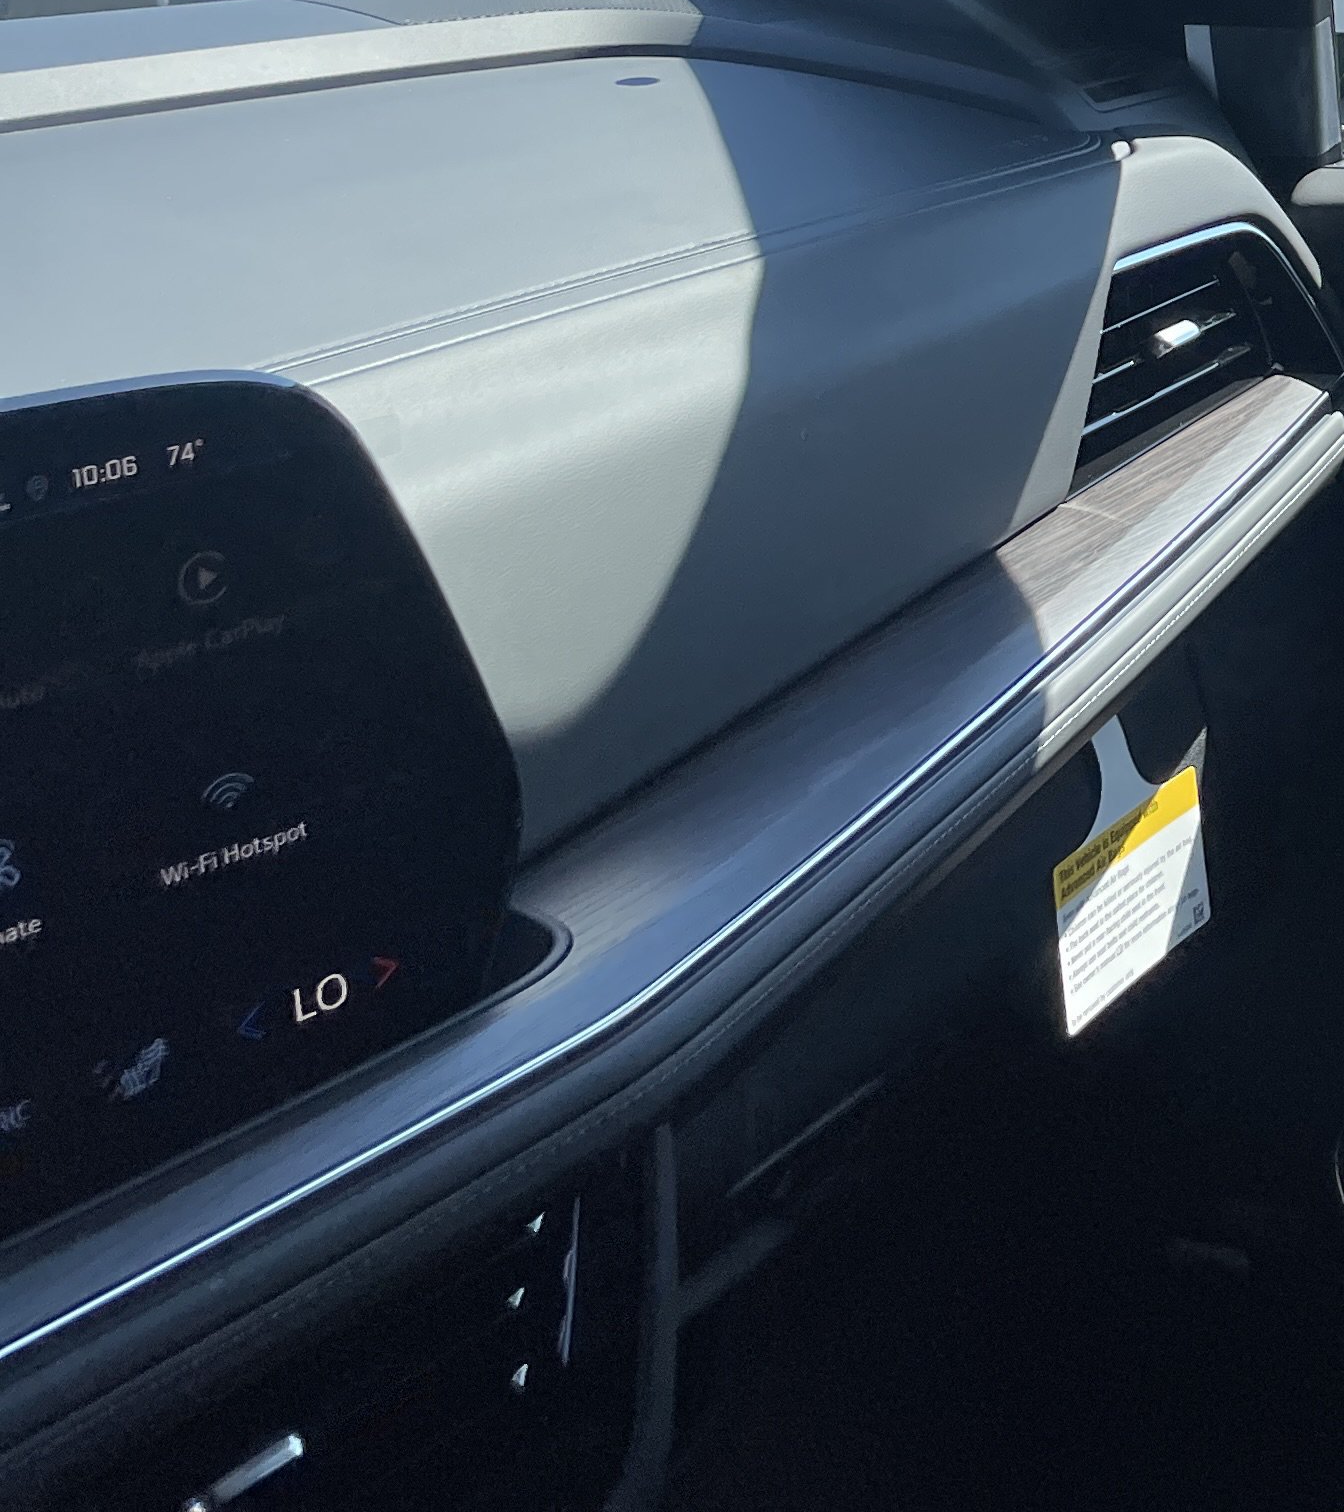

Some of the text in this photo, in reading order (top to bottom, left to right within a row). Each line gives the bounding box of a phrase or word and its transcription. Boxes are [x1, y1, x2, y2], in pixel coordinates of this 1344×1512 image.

[72, 454, 138, 489] 10:06
[160, 821, 308, 886] Wi-Fi Hotspot
[292, 974, 349, 1024] LO
